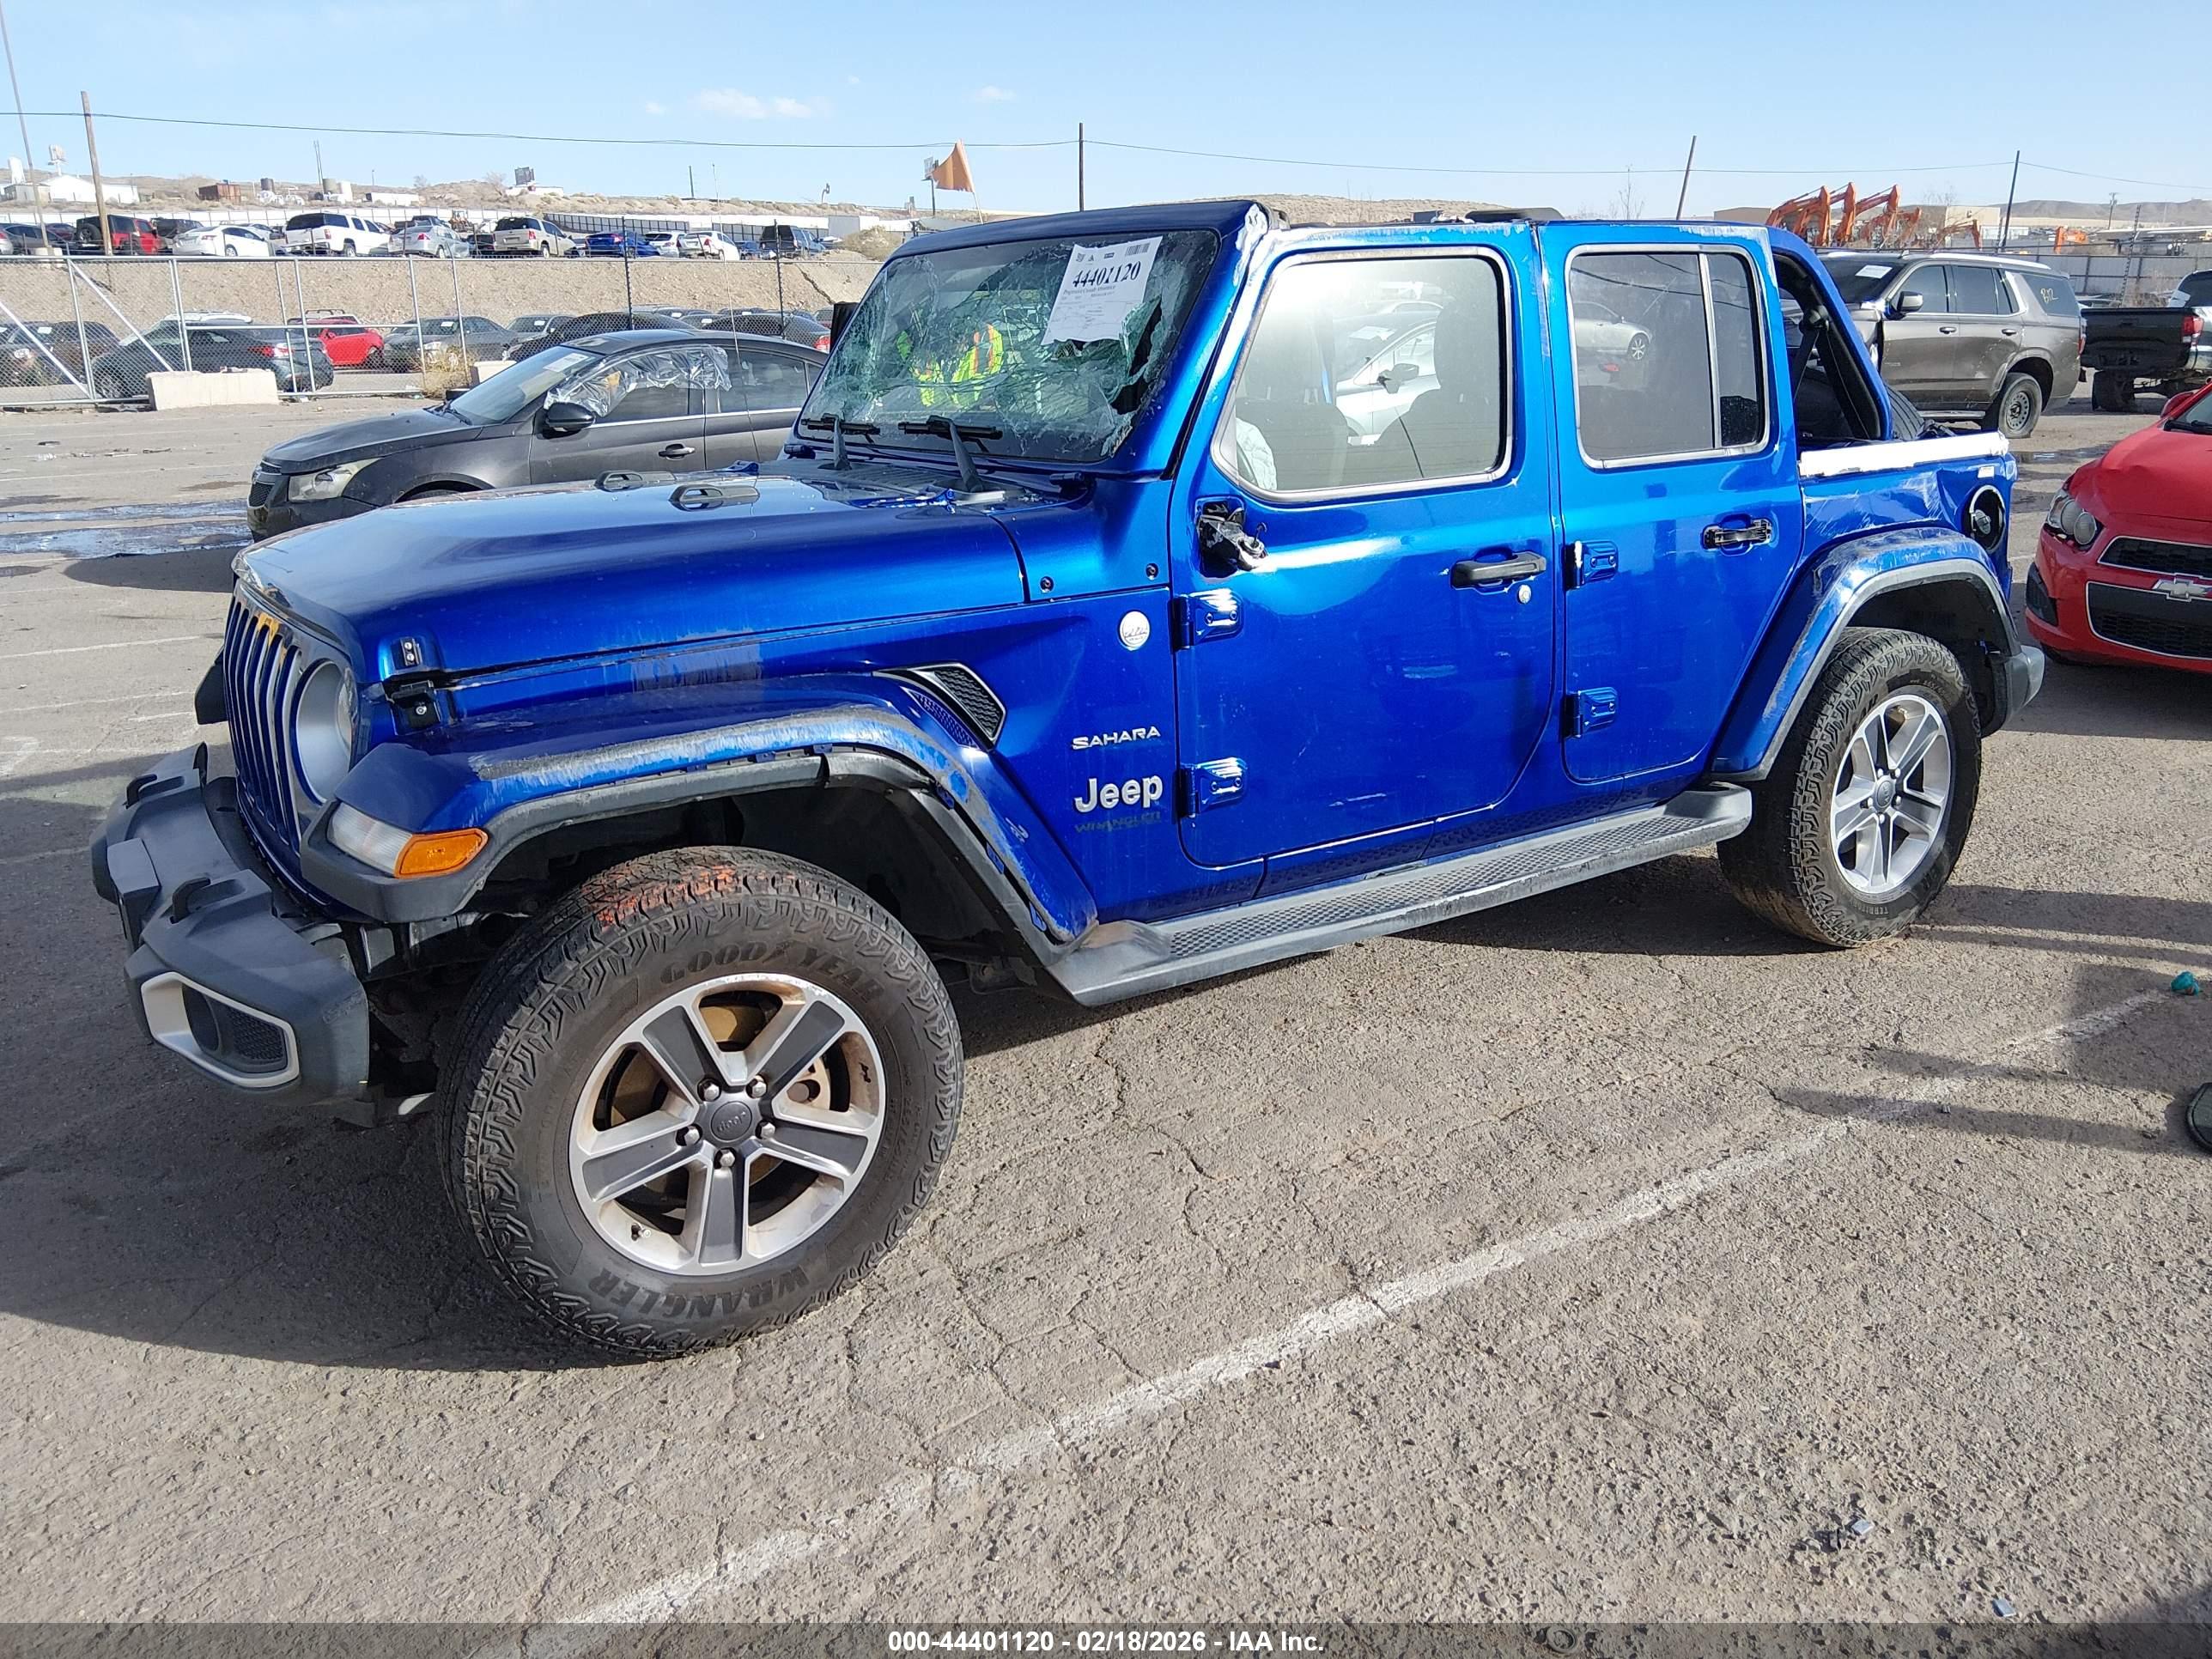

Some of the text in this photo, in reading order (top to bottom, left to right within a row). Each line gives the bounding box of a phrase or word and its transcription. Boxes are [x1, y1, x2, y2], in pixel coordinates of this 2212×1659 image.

[1073, 261, 1140, 287] 44401120
[1072, 726, 1161, 750] SAHARA
[1073, 775, 1164, 814] Jeep
[1073, 811, 1162, 834] WRANGLER
[588, 1264, 810, 1319] WRANGLER
